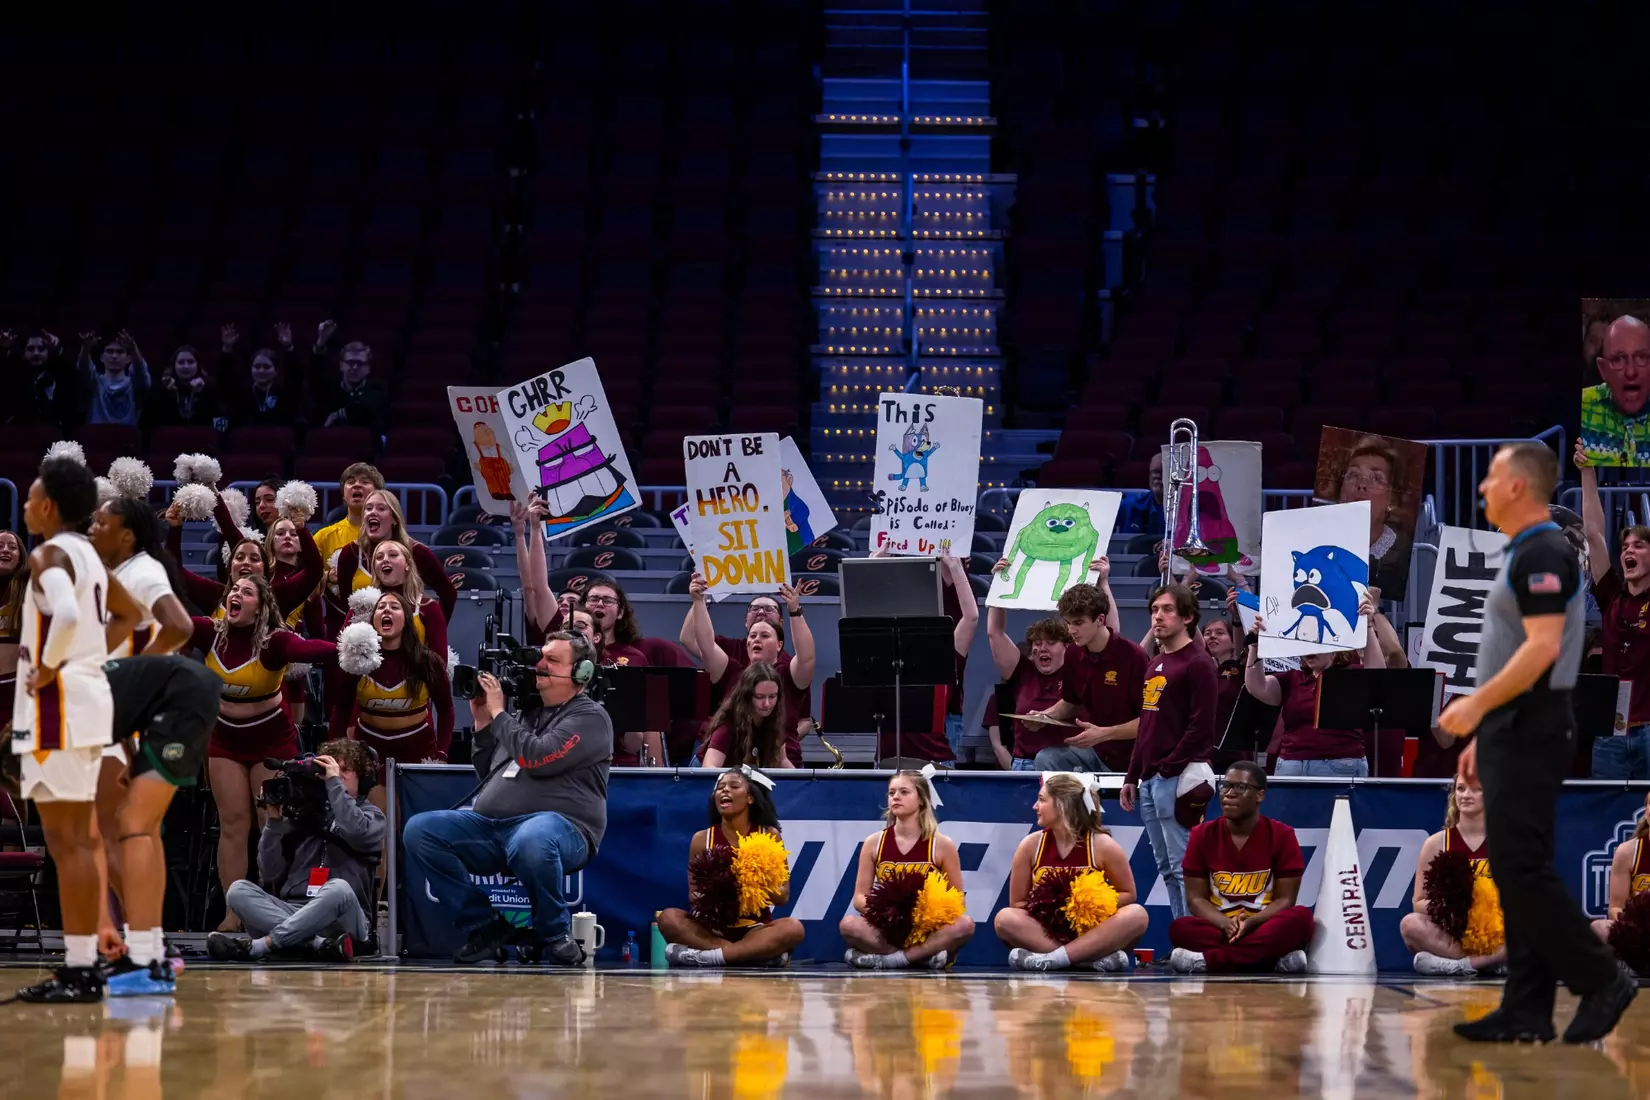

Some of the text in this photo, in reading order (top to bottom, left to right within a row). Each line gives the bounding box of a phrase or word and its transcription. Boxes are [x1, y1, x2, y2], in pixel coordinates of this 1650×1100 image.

[508, 370, 572, 418] GHRR
[688, 436, 764, 460] DON'T BE
[723, 462, 741, 482] A
[696, 483, 769, 516] HERO.
[718, 519, 759, 551] SIT
[890, 517, 901, 530] is
[702, 548, 785, 587] DOWN
[1213, 869, 1271, 896] CMU
[502, 894, 530, 903] Union
[1338, 864, 1367, 950] CENTRAL
